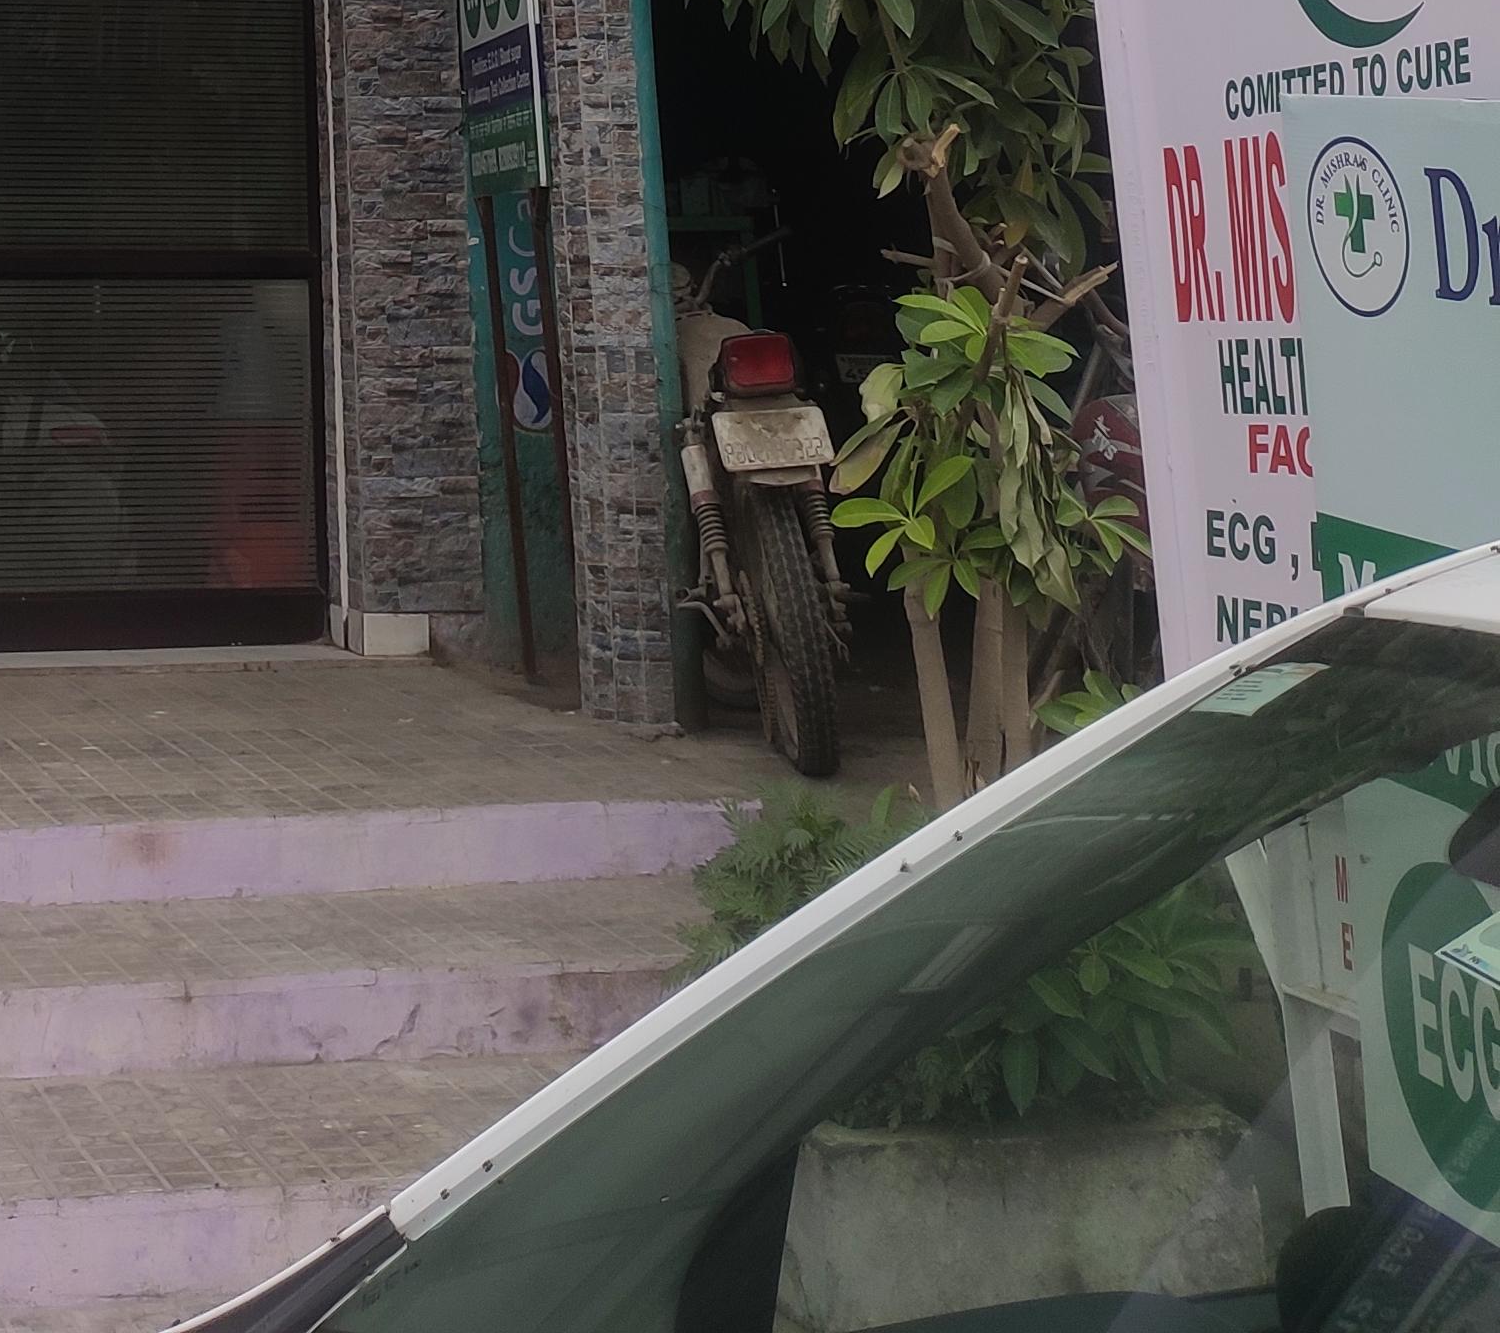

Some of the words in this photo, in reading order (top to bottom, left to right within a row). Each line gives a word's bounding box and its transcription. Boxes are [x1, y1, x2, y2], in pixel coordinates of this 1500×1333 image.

[1353, 53, 1387, 95] TO
[1397, 37, 1471, 94] CURE
[1320, 151, 1368, 189] MISHRA'S
[1371, 169, 1400, 233] CLINIC
[1162, 145, 1225, 323] DR.
[1206, 509, 1276, 564] ECG
